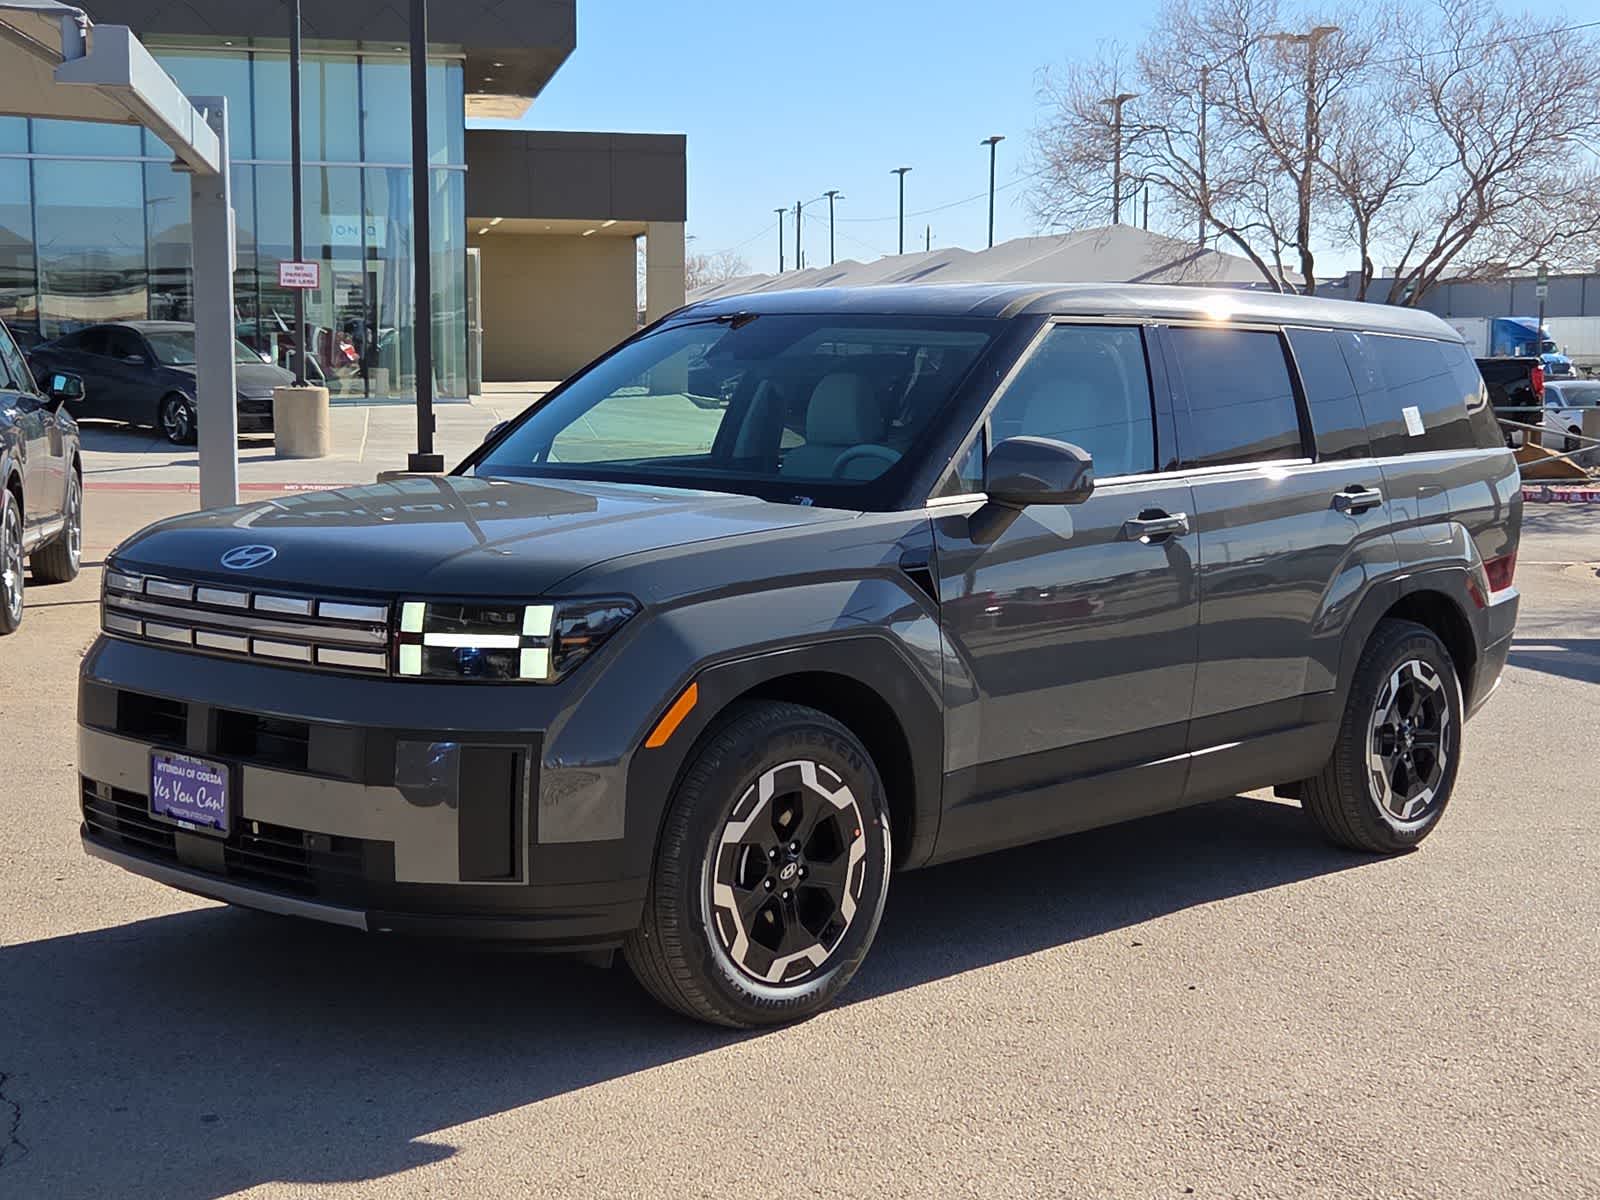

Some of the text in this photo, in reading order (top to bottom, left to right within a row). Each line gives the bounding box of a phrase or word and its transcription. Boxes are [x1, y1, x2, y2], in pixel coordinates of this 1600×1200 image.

[186, 768, 195, 780] OF
[196, 770, 222, 785] ODESSA
[153, 775, 170, 799] Yes
[173, 780, 194, 802] You
[196, 786, 225, 813] Can!
